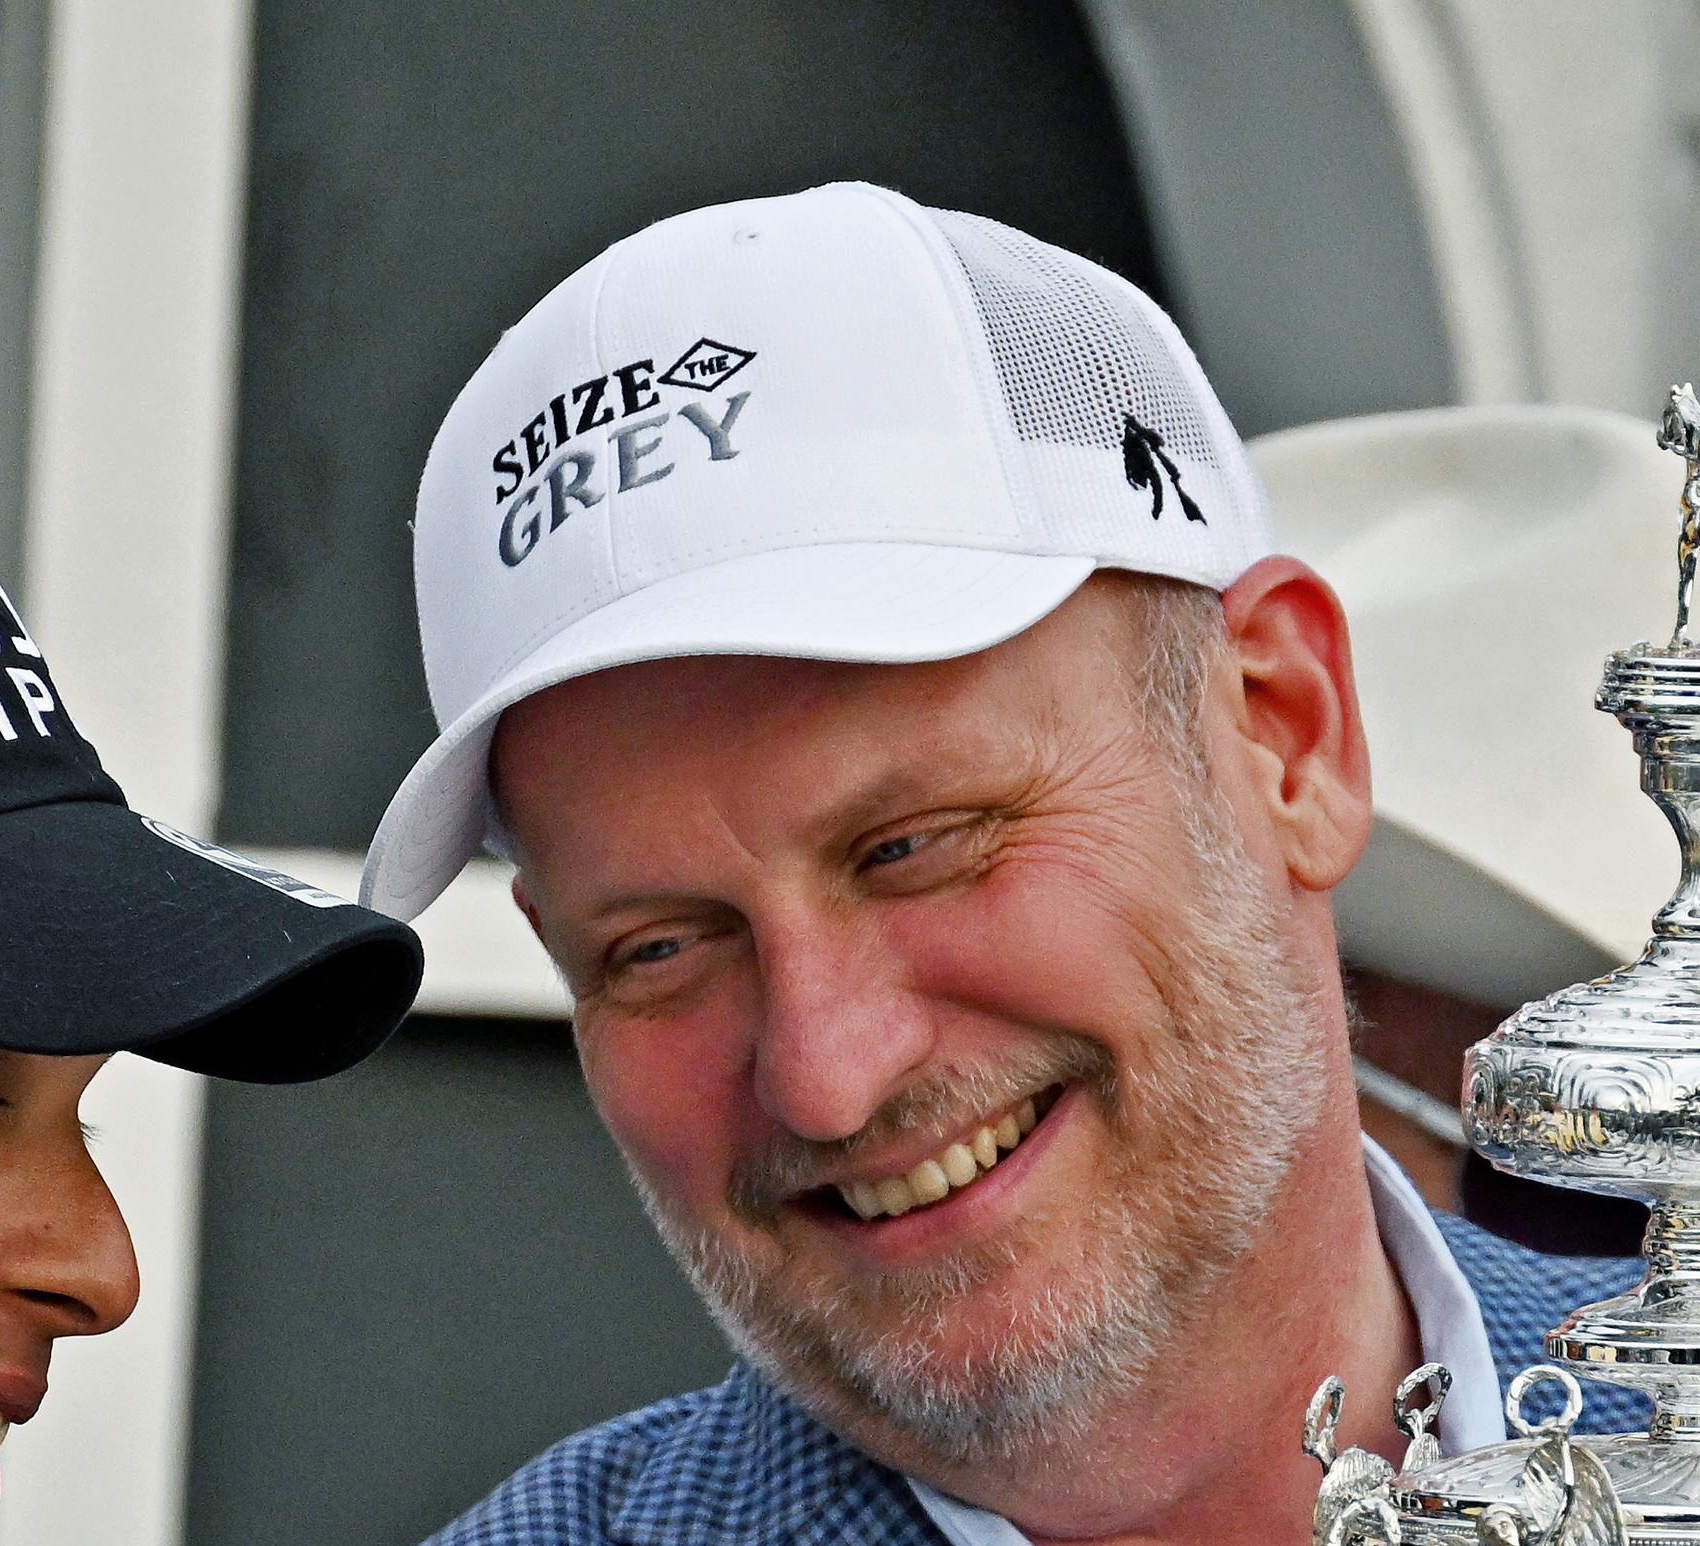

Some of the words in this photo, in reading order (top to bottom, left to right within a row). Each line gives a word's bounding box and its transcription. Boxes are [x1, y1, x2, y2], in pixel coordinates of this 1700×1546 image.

[493, 358, 661, 505] SEIZE
[684, 354, 730, 381] THE
[498, 391, 752, 567] GREY
